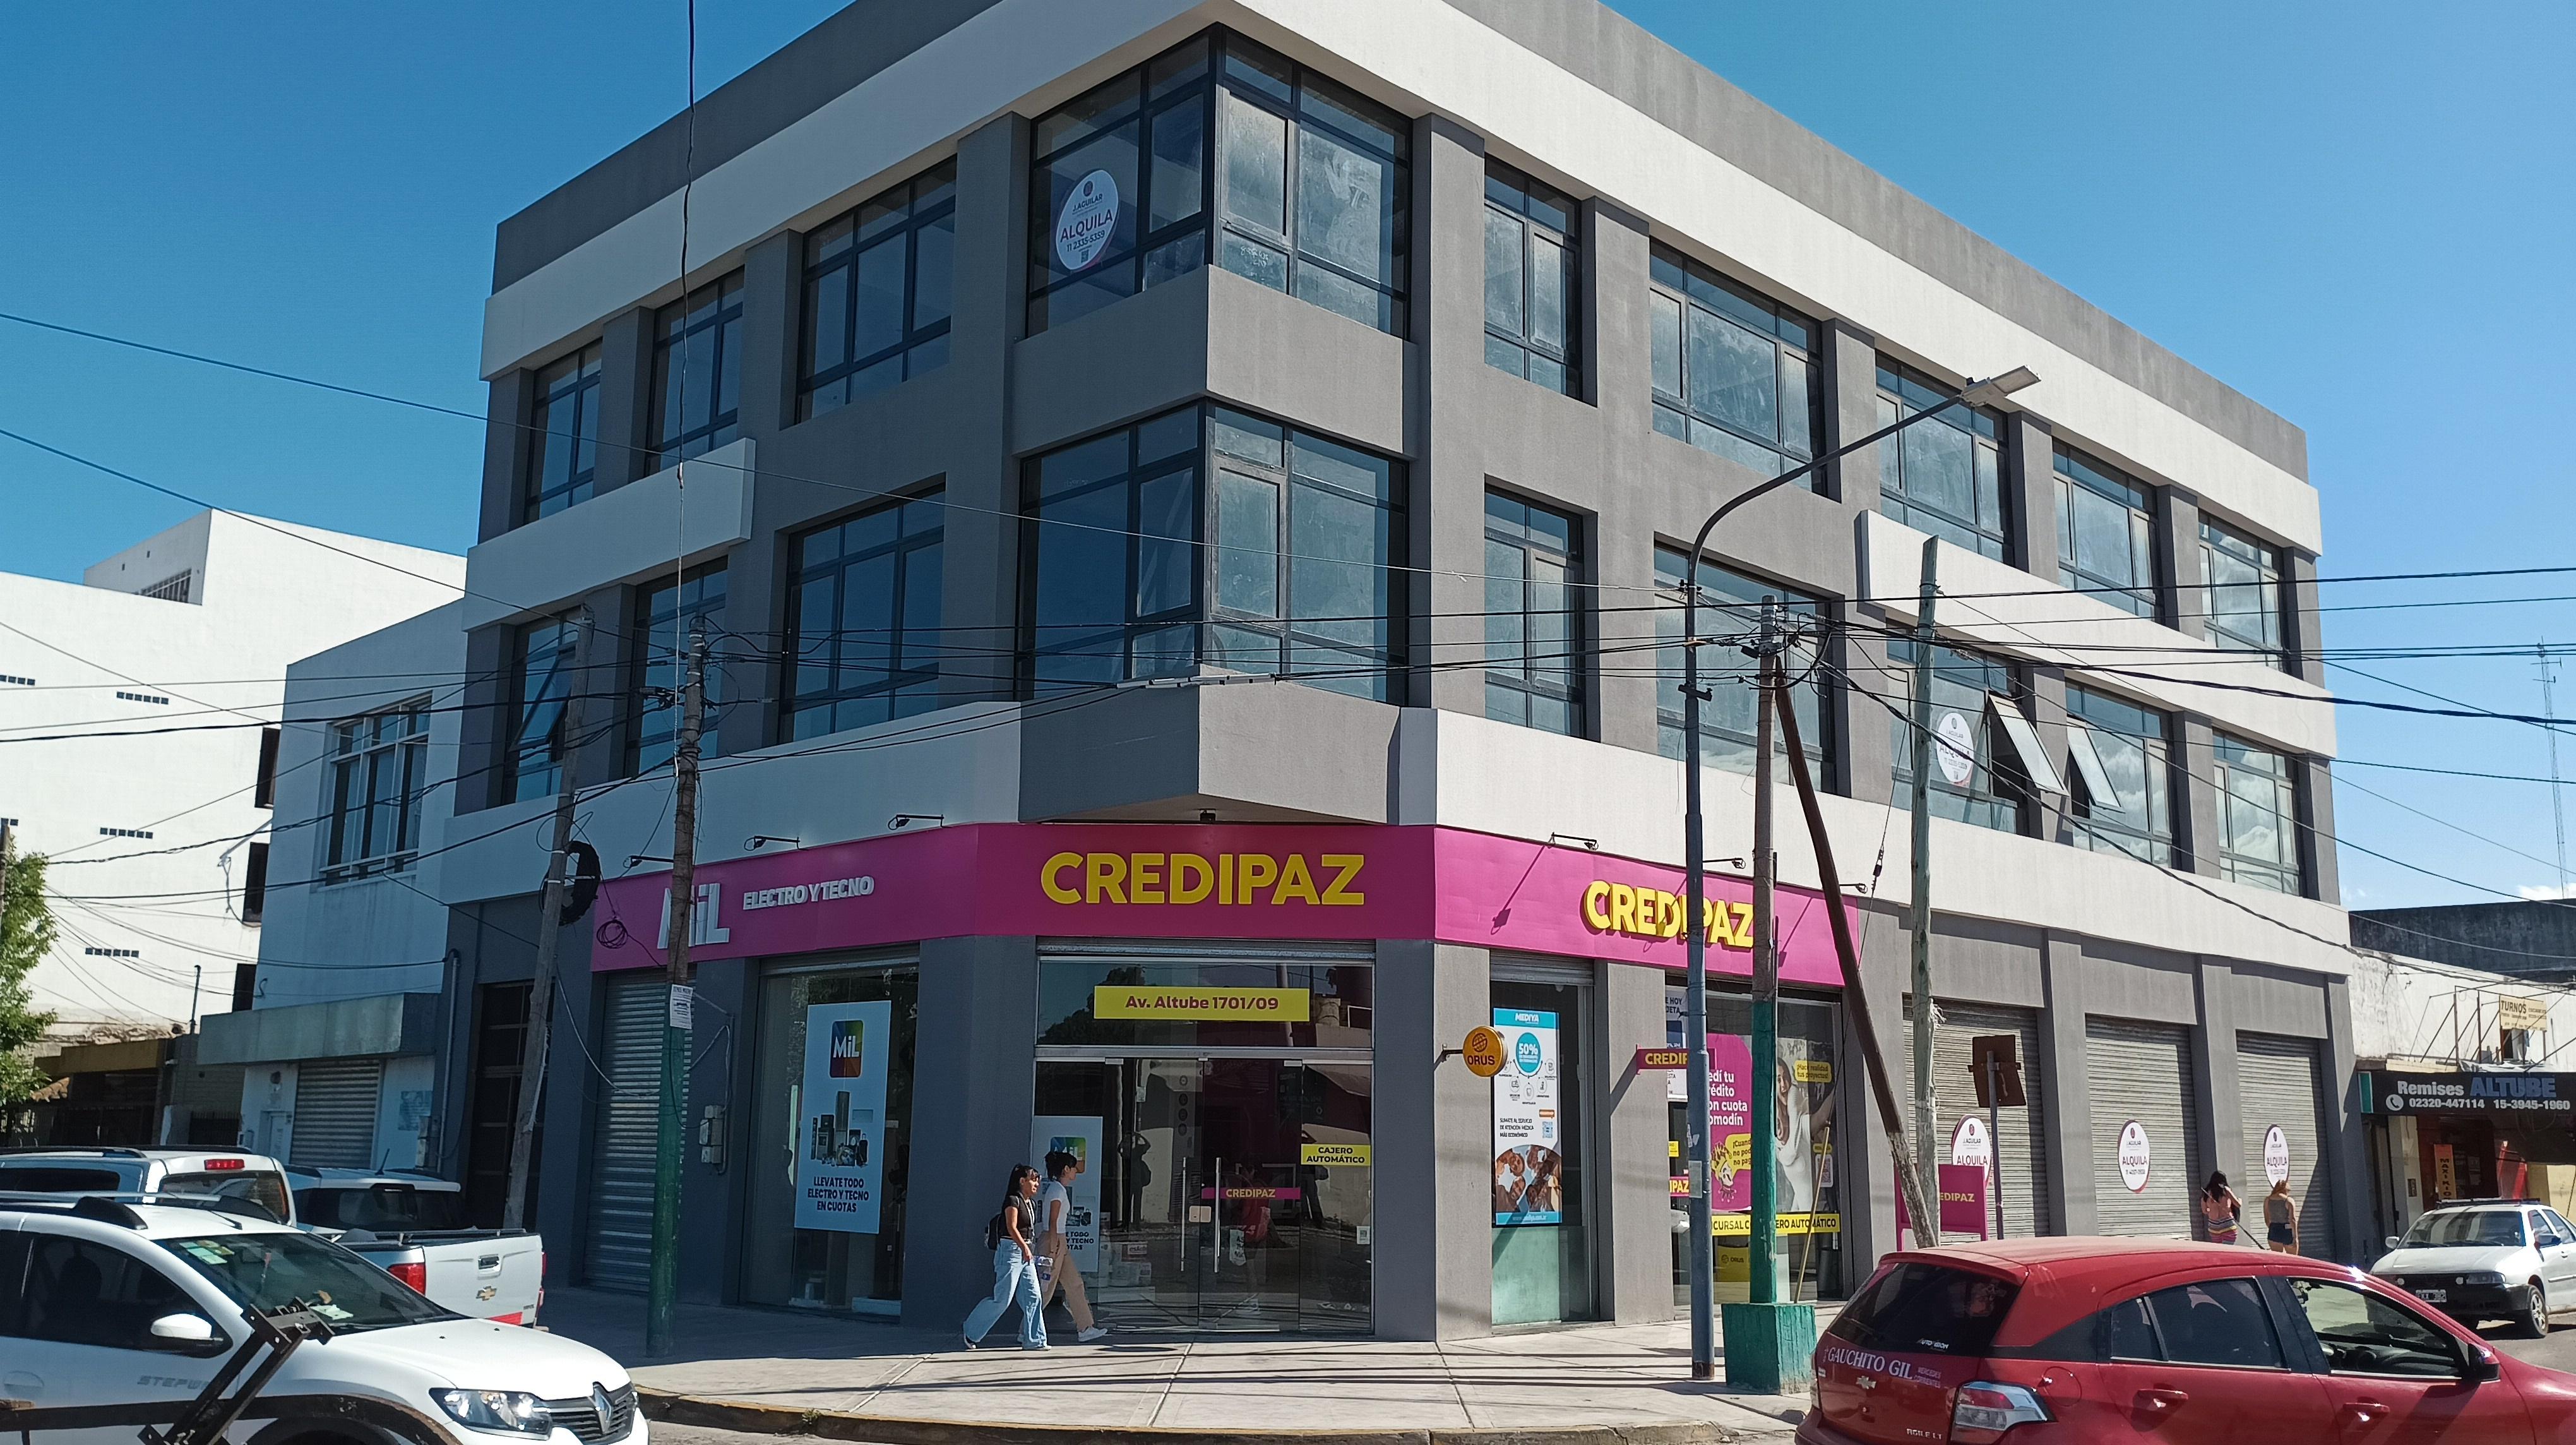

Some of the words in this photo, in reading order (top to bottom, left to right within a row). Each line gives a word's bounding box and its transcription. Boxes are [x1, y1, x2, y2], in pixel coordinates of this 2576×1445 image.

[1073, 194, 1102, 212] J.AGUILAR
[1060, 209, 1112, 243] ALQUILA
[1041, 852, 1364, 905] CREDIPAZ
[743, 885, 808, 910] ELECTRO
[808, 884, 820, 902] Y
[821, 876, 874, 900] TECNO
[1125, 996, 1151, 1008] Av.
[1154, 996, 1209, 1009] Altube
[1212, 997, 1279, 1009] 1701/09
[1670, 997, 1683, 1005] HOY
[2501, 1000, 2527, 1014] TURNOS
[833, 1035, 859, 1058] MiL
[1518, 1043, 1539, 1055] 50%
[1467, 1055, 1495, 1065] ORUS
[1645, 1053, 1688, 1065] CREDIP
[1709, 1069, 1722, 1082] edí
[1724, 1071, 1734, 1082] tu
[1709, 1083, 1734, 1097] édito
[2397, 1081, 2464, 1096] Remises
[2469, 1077, 2556, 1098] ALTUBE
[1709, 1100, 1719, 1111] on
[1722, 1100, 1748, 1112] cuota
[2409, 1098, 2485, 1108] 02320-447114
[2493, 1100, 2570, 1110] 15-3945-1960
[1709, 1113, 1743, 1126] omodín
[1306, 1154, 1365, 1163] AUTOMÁTICO
[1957, 1154, 1988, 1165] ALQUILA
[2122, 1156, 2148, 1167] ALQUILA
[2267, 1156, 2287, 1168] ALQUILA
[813, 1177, 843, 1187] LLEVATE
[844, 1178, 864, 1188] TODO
[808, 1188, 838, 1199] ELECTRO
[838, 1190, 844, 1199] Y
[845, 1190, 869, 1201] TECNO
[1225, 1189, 1275, 1197] CREDIPAZ
[1940, 1192, 1975, 1202] EDIPAZ
[817, 1201, 826, 1210] EN
[827, 1201, 857, 1213] CUOTAS
[1713, 1220, 1743, 1230] CURSAL
[1828, 1347, 1885, 1372] GAUCHITO
[1888, 1360, 1912, 1379] GIL
